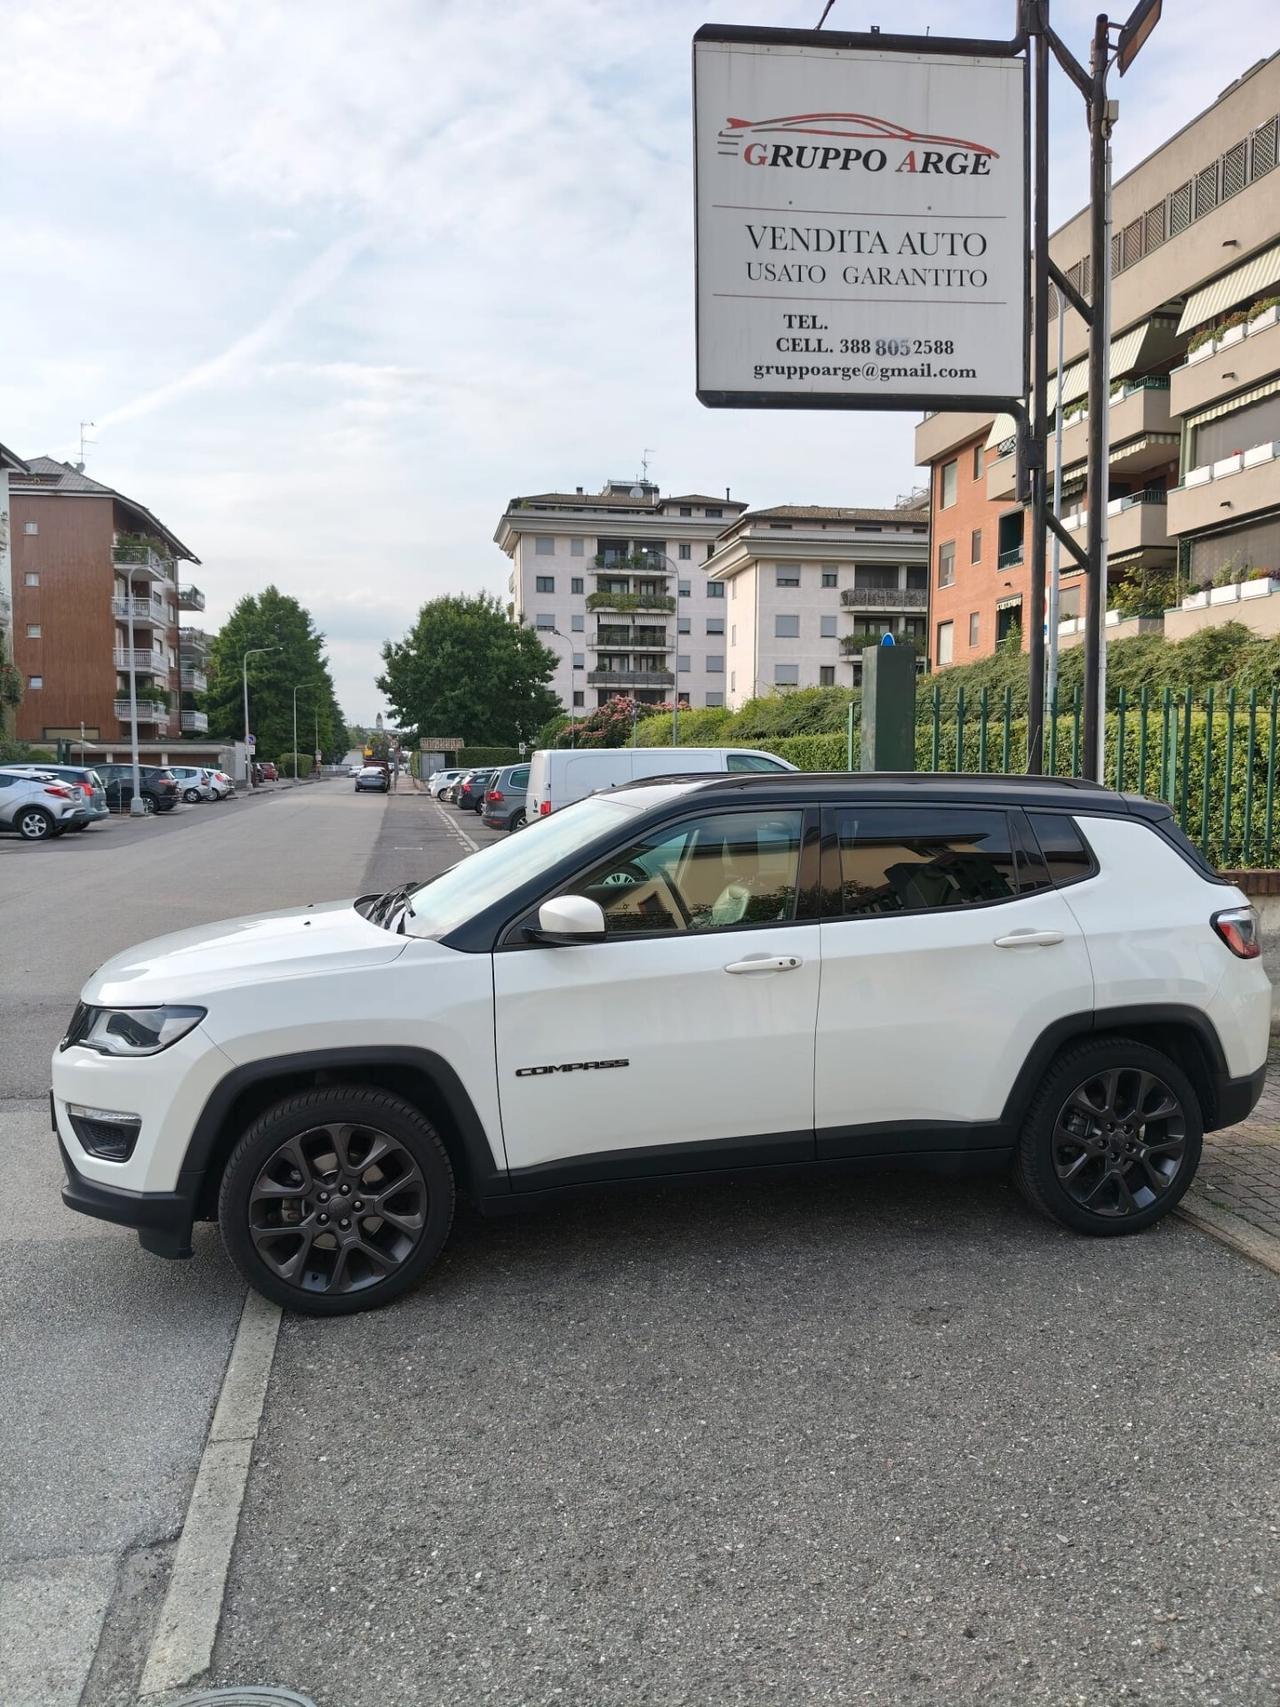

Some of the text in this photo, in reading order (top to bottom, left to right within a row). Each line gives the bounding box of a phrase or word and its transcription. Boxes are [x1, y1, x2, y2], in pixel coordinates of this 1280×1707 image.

[744, 143, 992, 175] GRUPPO ARGE
[745, 225, 987, 257] VENDITA AUTO
[746, 262, 988, 288] USATO GARANTITO
[783, 314, 828, 330] TEL.
[776, 337, 834, 353] CELL.
[753, 362, 977, 382] gruppoarge@gmail.com
[515, 1058, 630, 1077] COMPASS
